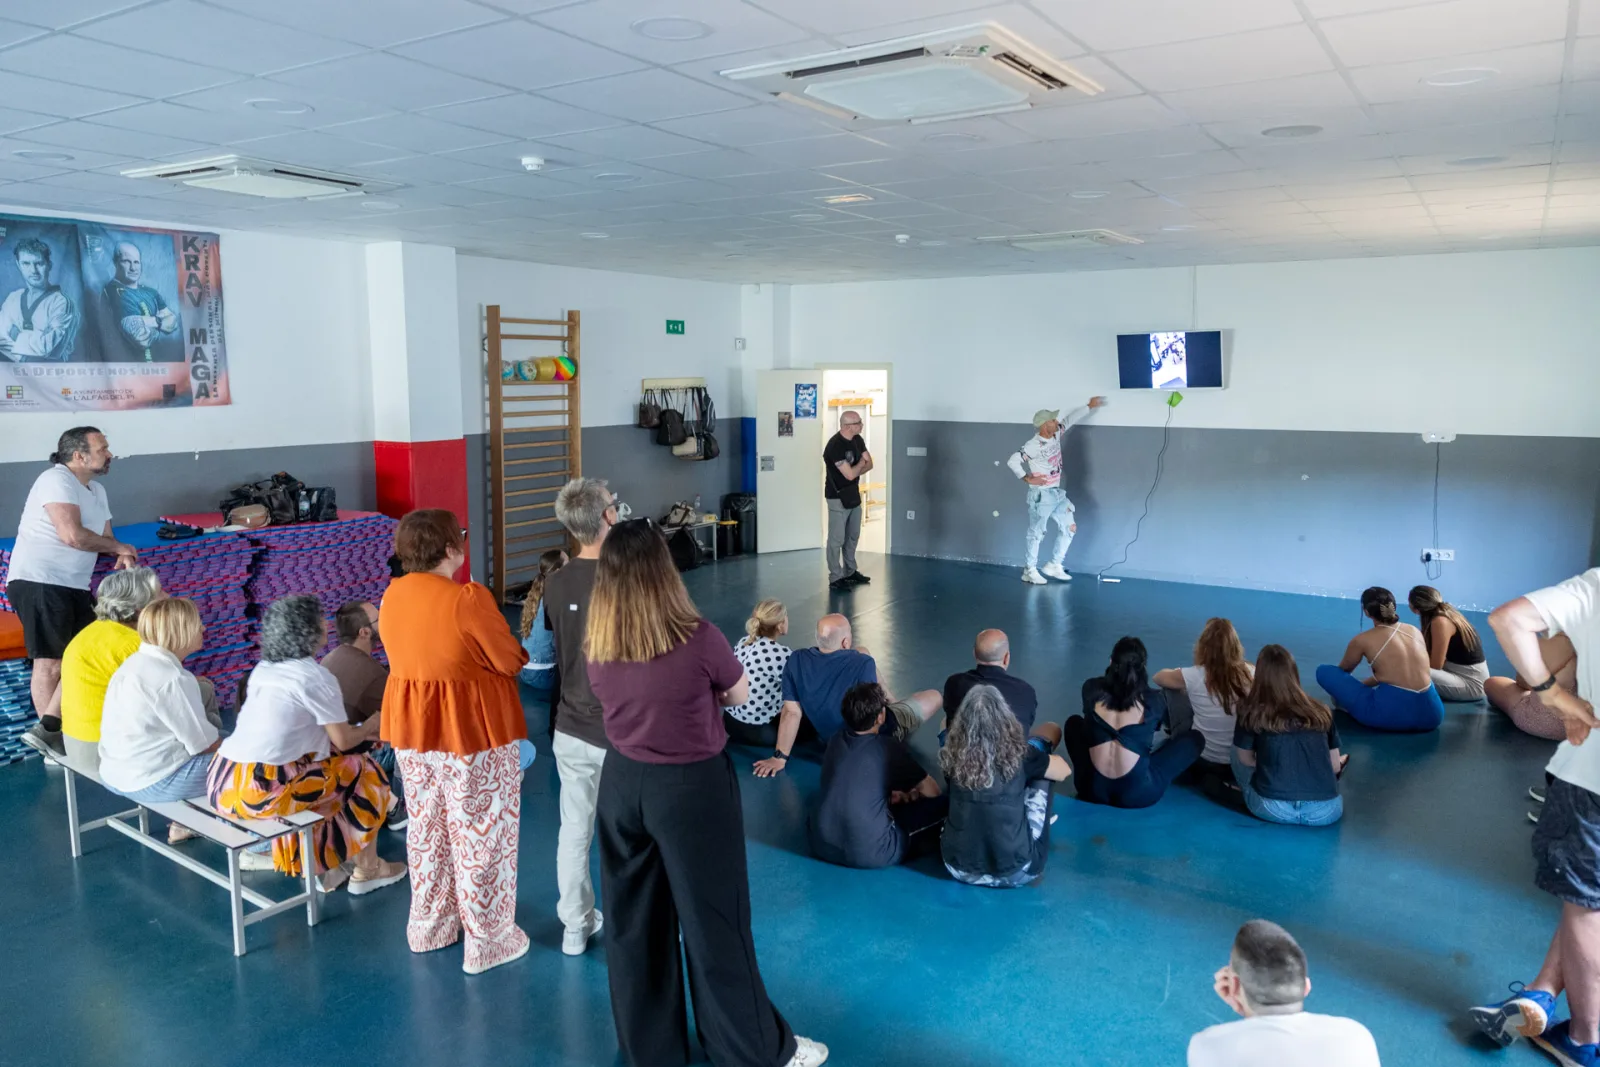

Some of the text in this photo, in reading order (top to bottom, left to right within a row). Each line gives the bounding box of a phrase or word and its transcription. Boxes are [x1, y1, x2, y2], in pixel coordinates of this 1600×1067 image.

[182, 235, 210, 399] KRAV MAGA
[13, 367, 28, 377] EL
